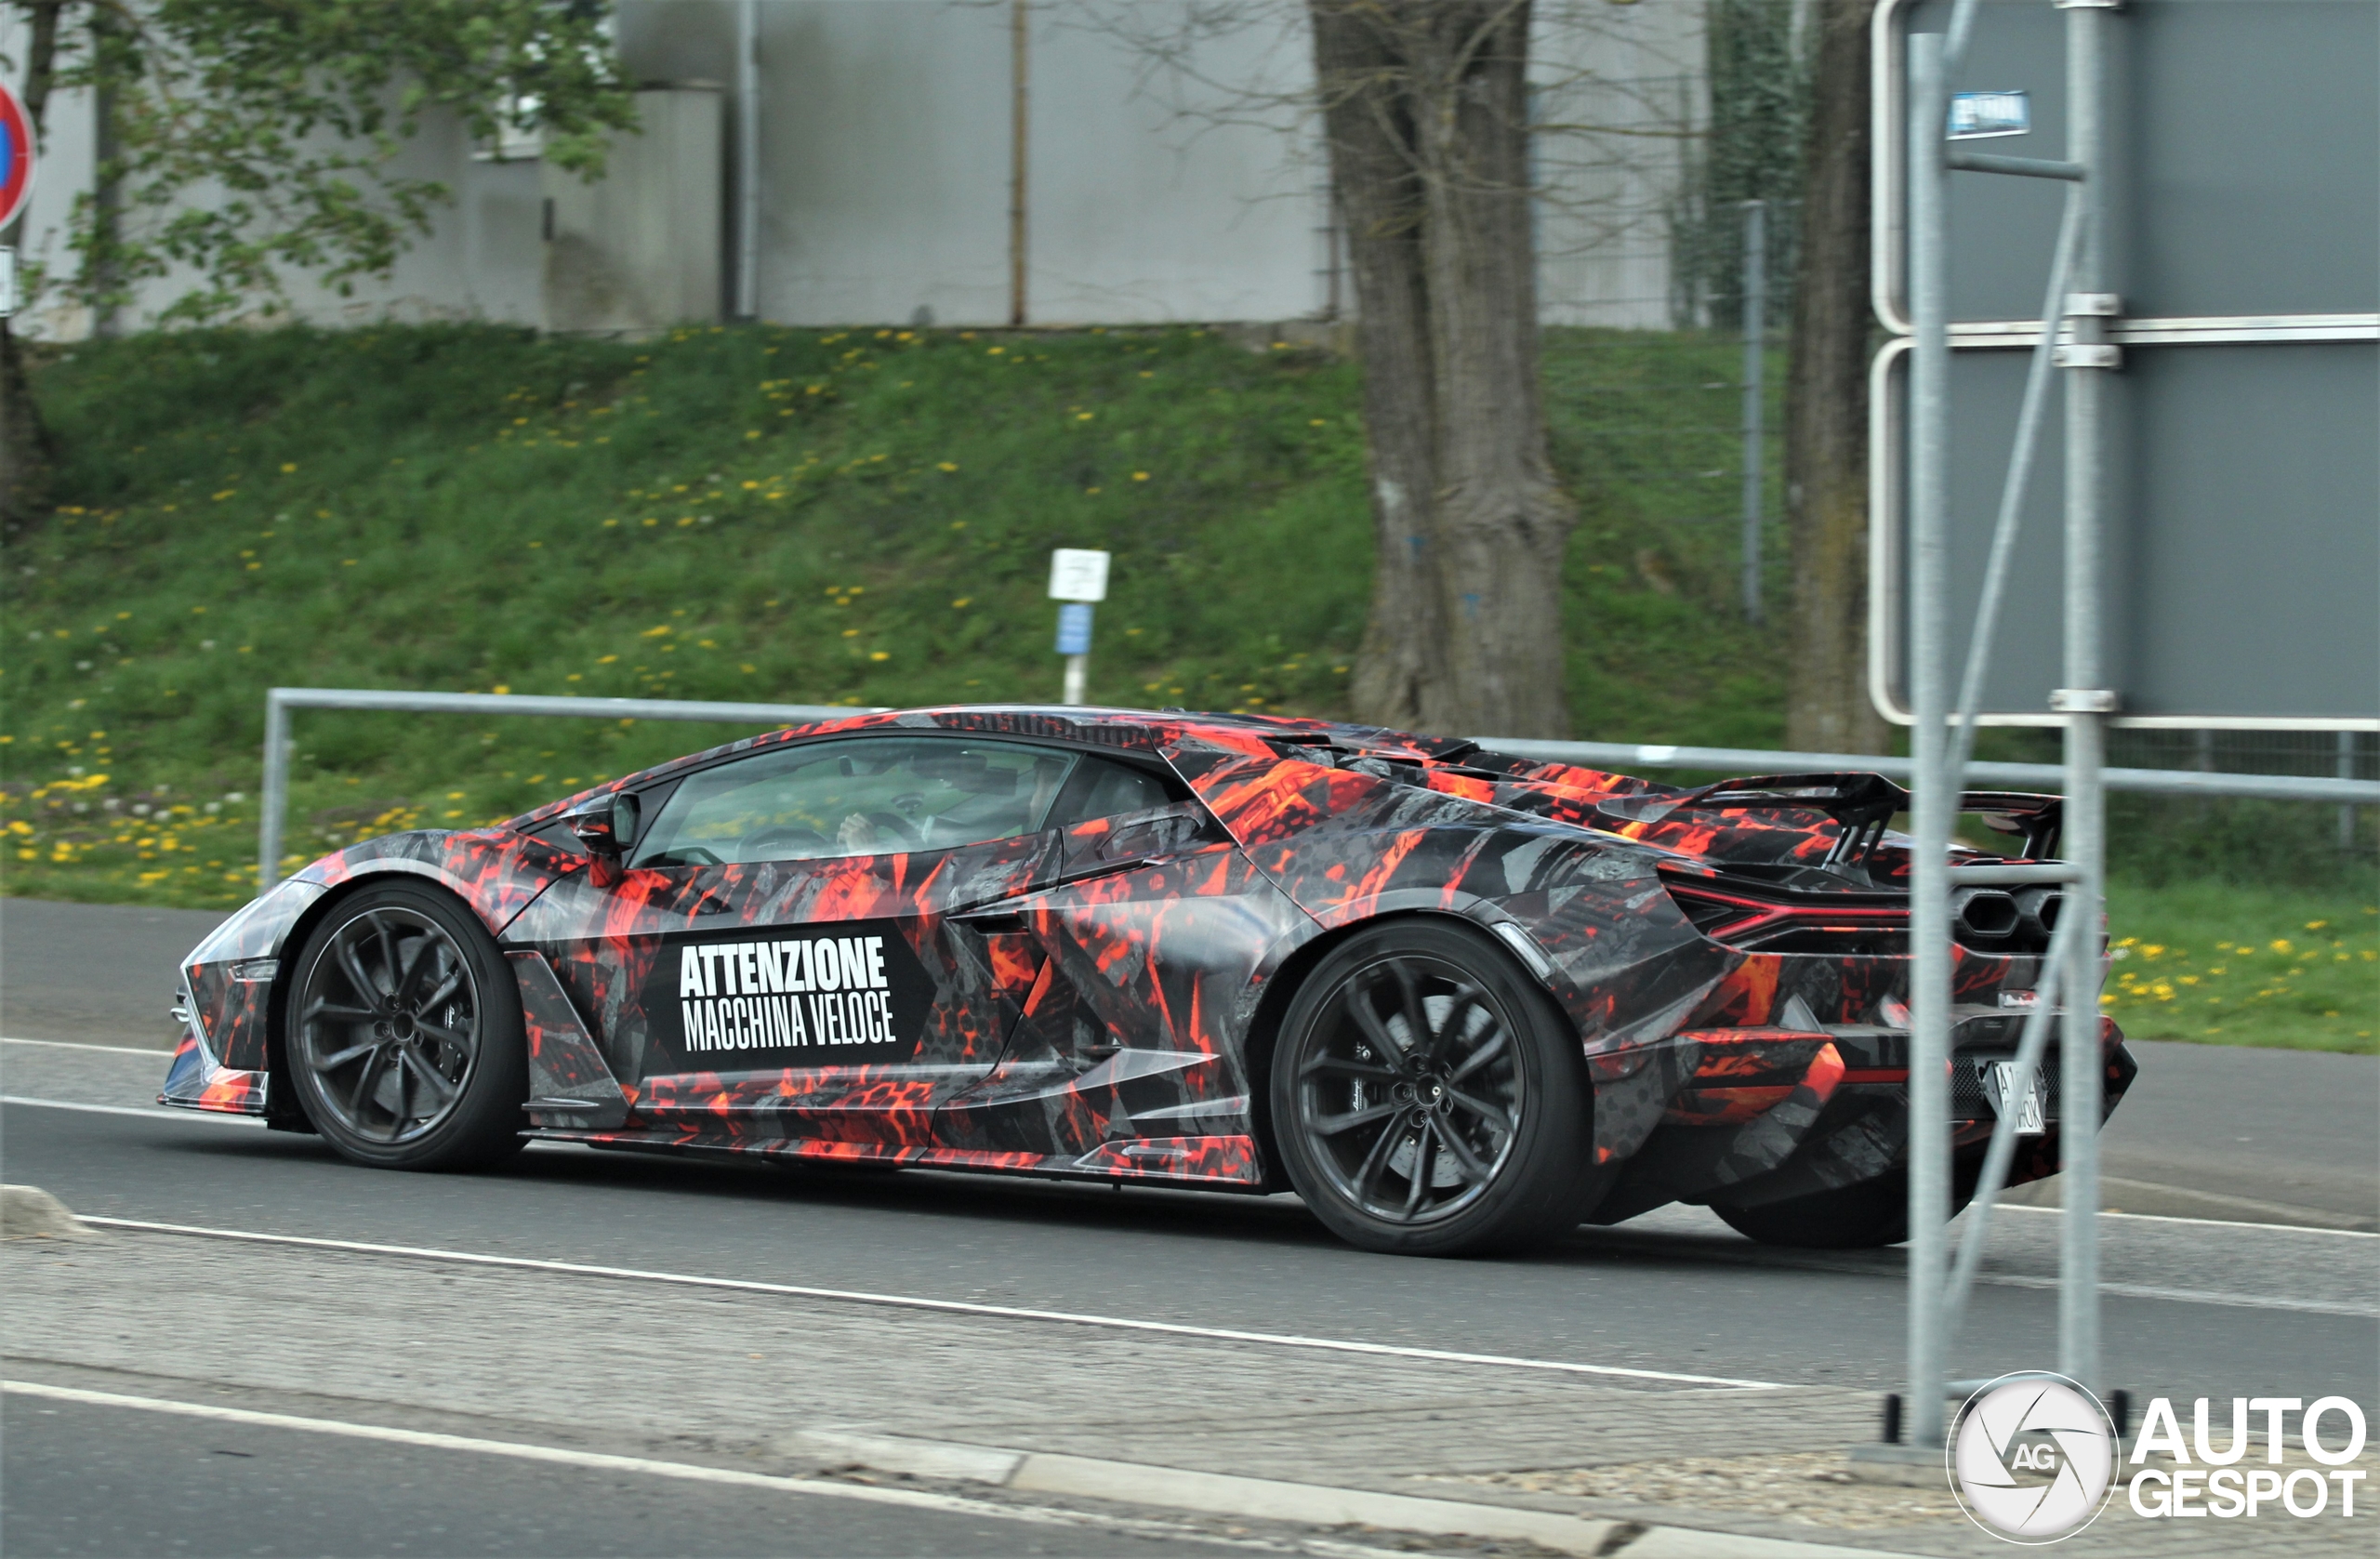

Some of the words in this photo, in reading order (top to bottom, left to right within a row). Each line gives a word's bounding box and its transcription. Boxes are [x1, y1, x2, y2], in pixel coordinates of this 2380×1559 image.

[680, 936, 888, 997] ATTENZIONE
[682, 995, 808, 1051] MACCHINA
[809, 990, 896, 1046] VELOCE
